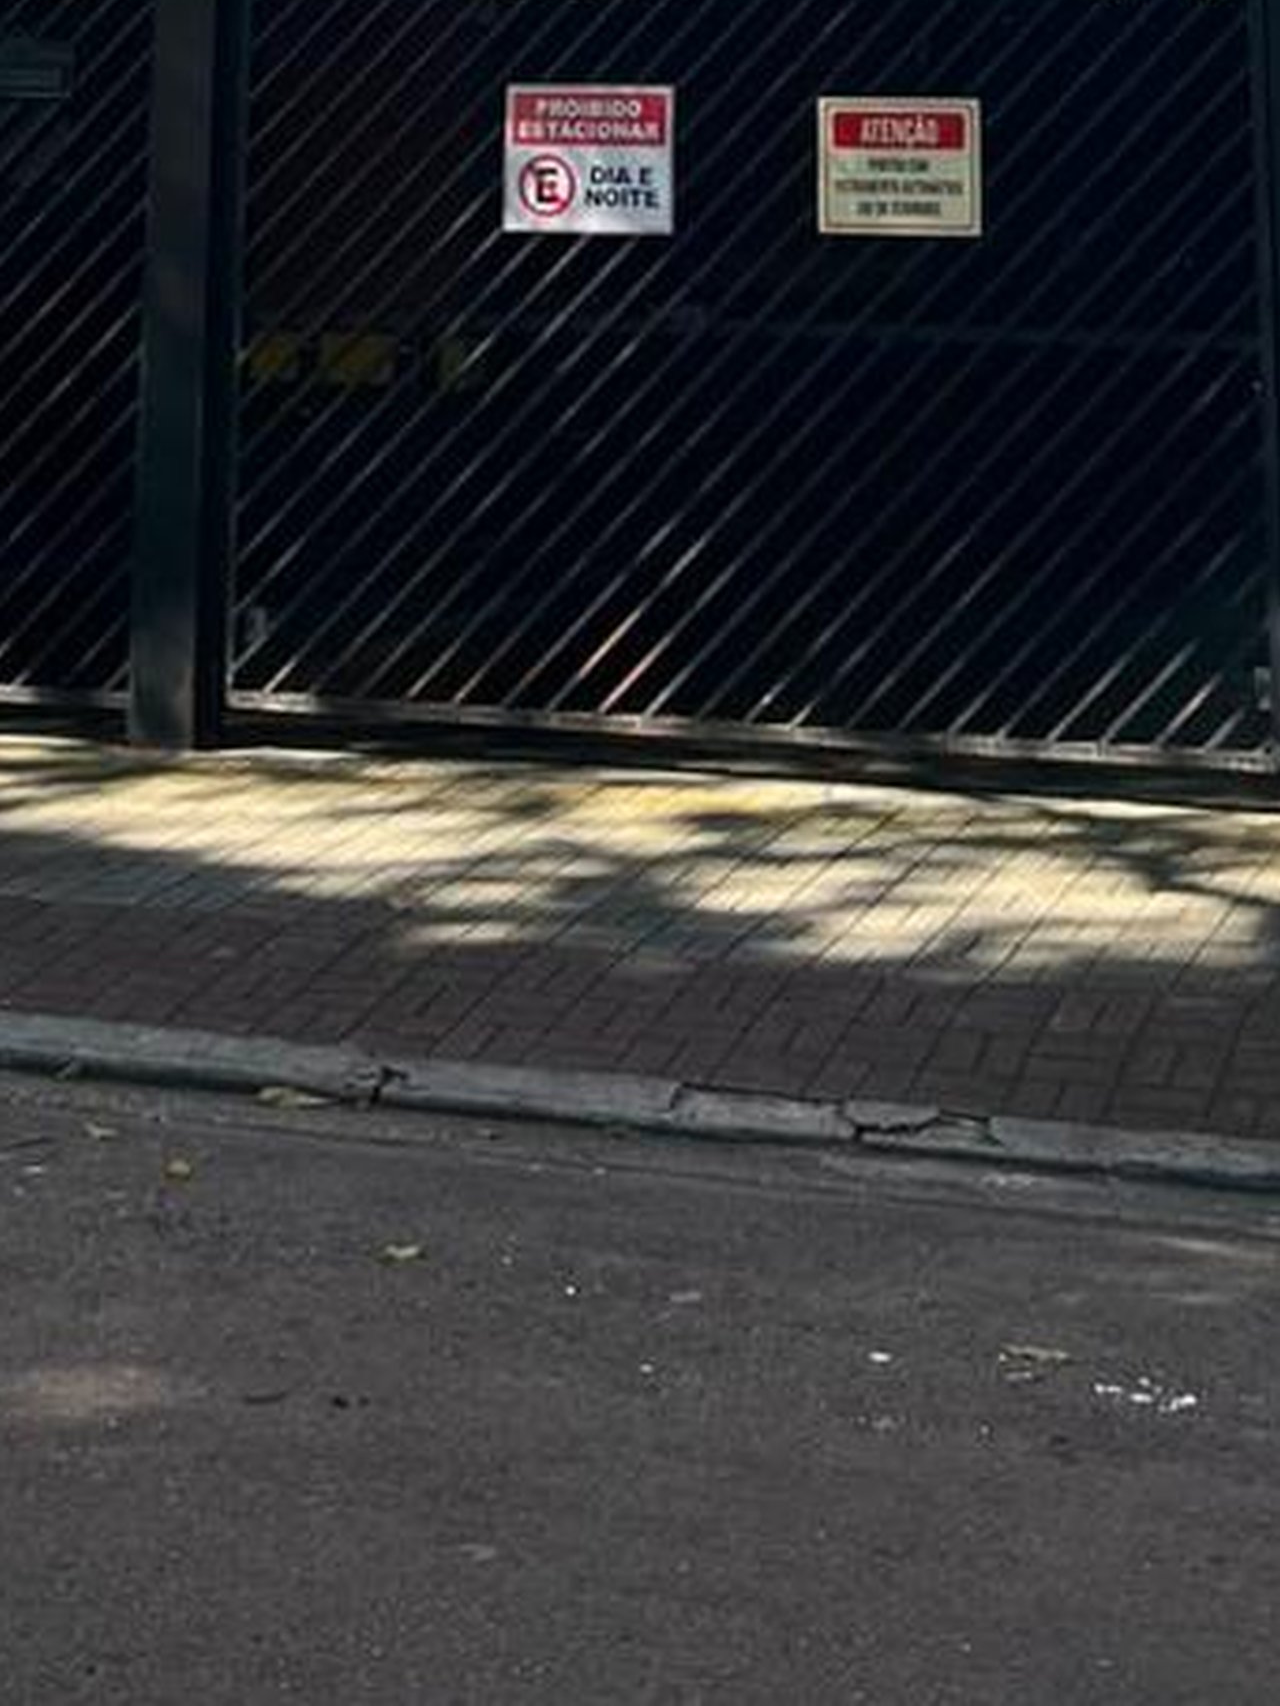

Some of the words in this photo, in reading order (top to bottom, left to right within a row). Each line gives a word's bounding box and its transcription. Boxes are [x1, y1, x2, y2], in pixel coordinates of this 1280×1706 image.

[535, 98, 642, 118] PROIBIDO
[518, 120, 661, 139] ESTACIONAR
[859, 114, 939, 148] ATENÇÃO
[590, 166, 631, 185] DIA
[639, 166, 652, 185] E
[584, 188, 660, 208] NOITE
